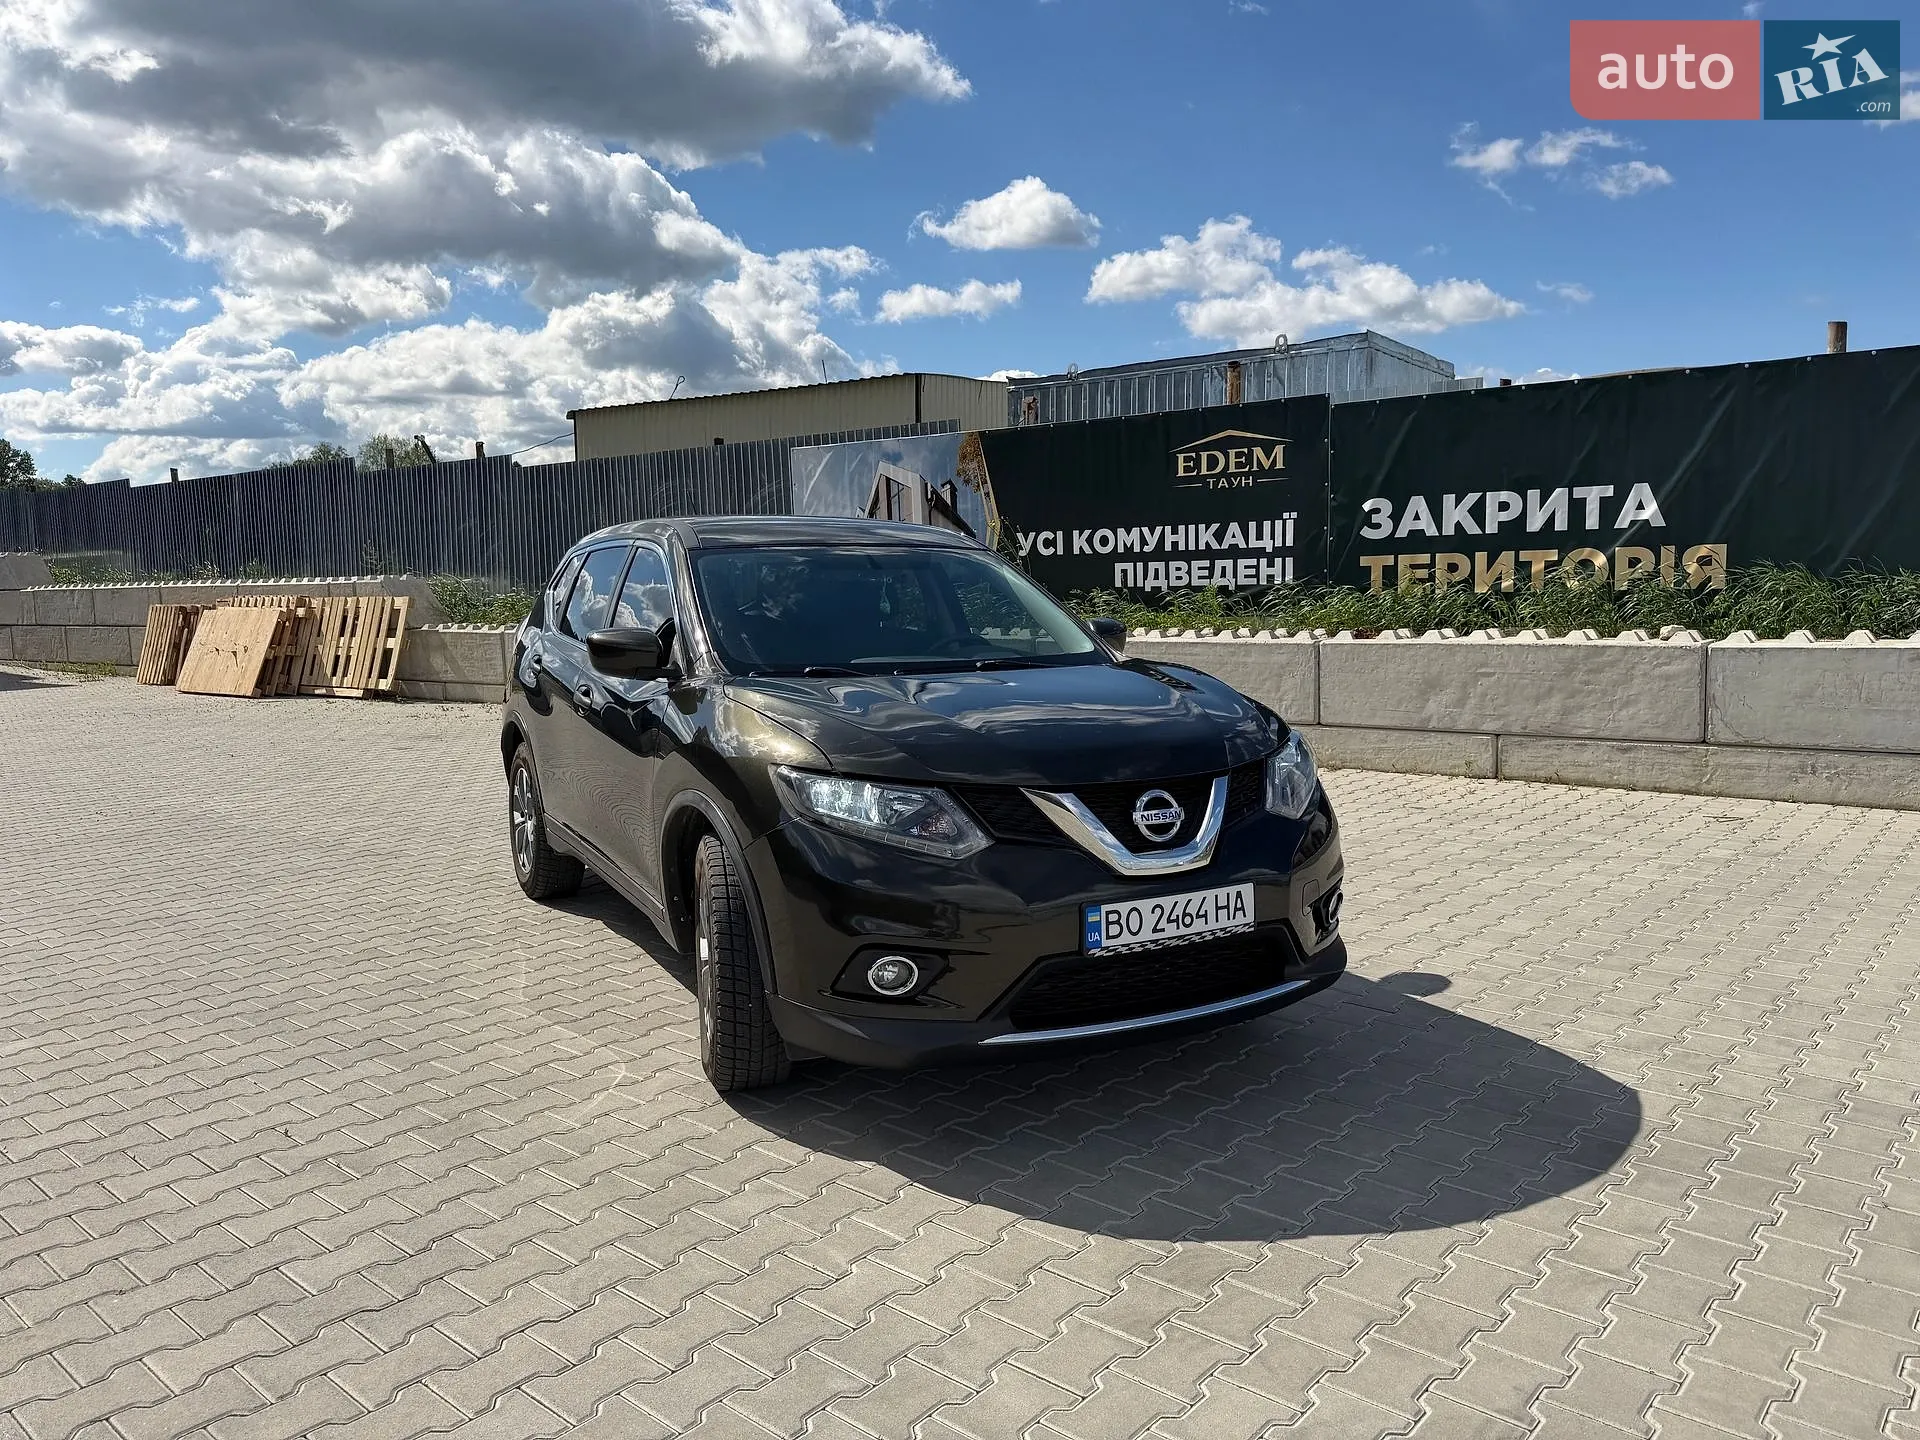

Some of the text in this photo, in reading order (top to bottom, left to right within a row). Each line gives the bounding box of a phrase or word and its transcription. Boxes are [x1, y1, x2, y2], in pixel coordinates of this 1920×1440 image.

[1175, 444, 1287, 477] EDEM
[1206, 476, 1254, 490] ТАУН
[1359, 482, 1667, 540] ЗАКРИТА
[1016, 511, 1298, 557] УСІ КОМУНІКАЦІЇ
[1114, 556, 1294, 592] ПІДВЕДЕНІ
[1359, 543, 1729, 594] ТЕРИТОРІЯ
[1140, 810, 1181, 823] NISSAN
[1104, 906, 1144, 941] BO
[1150, 895, 1209, 935] 2464
[1087, 932, 1101, 943] UA
